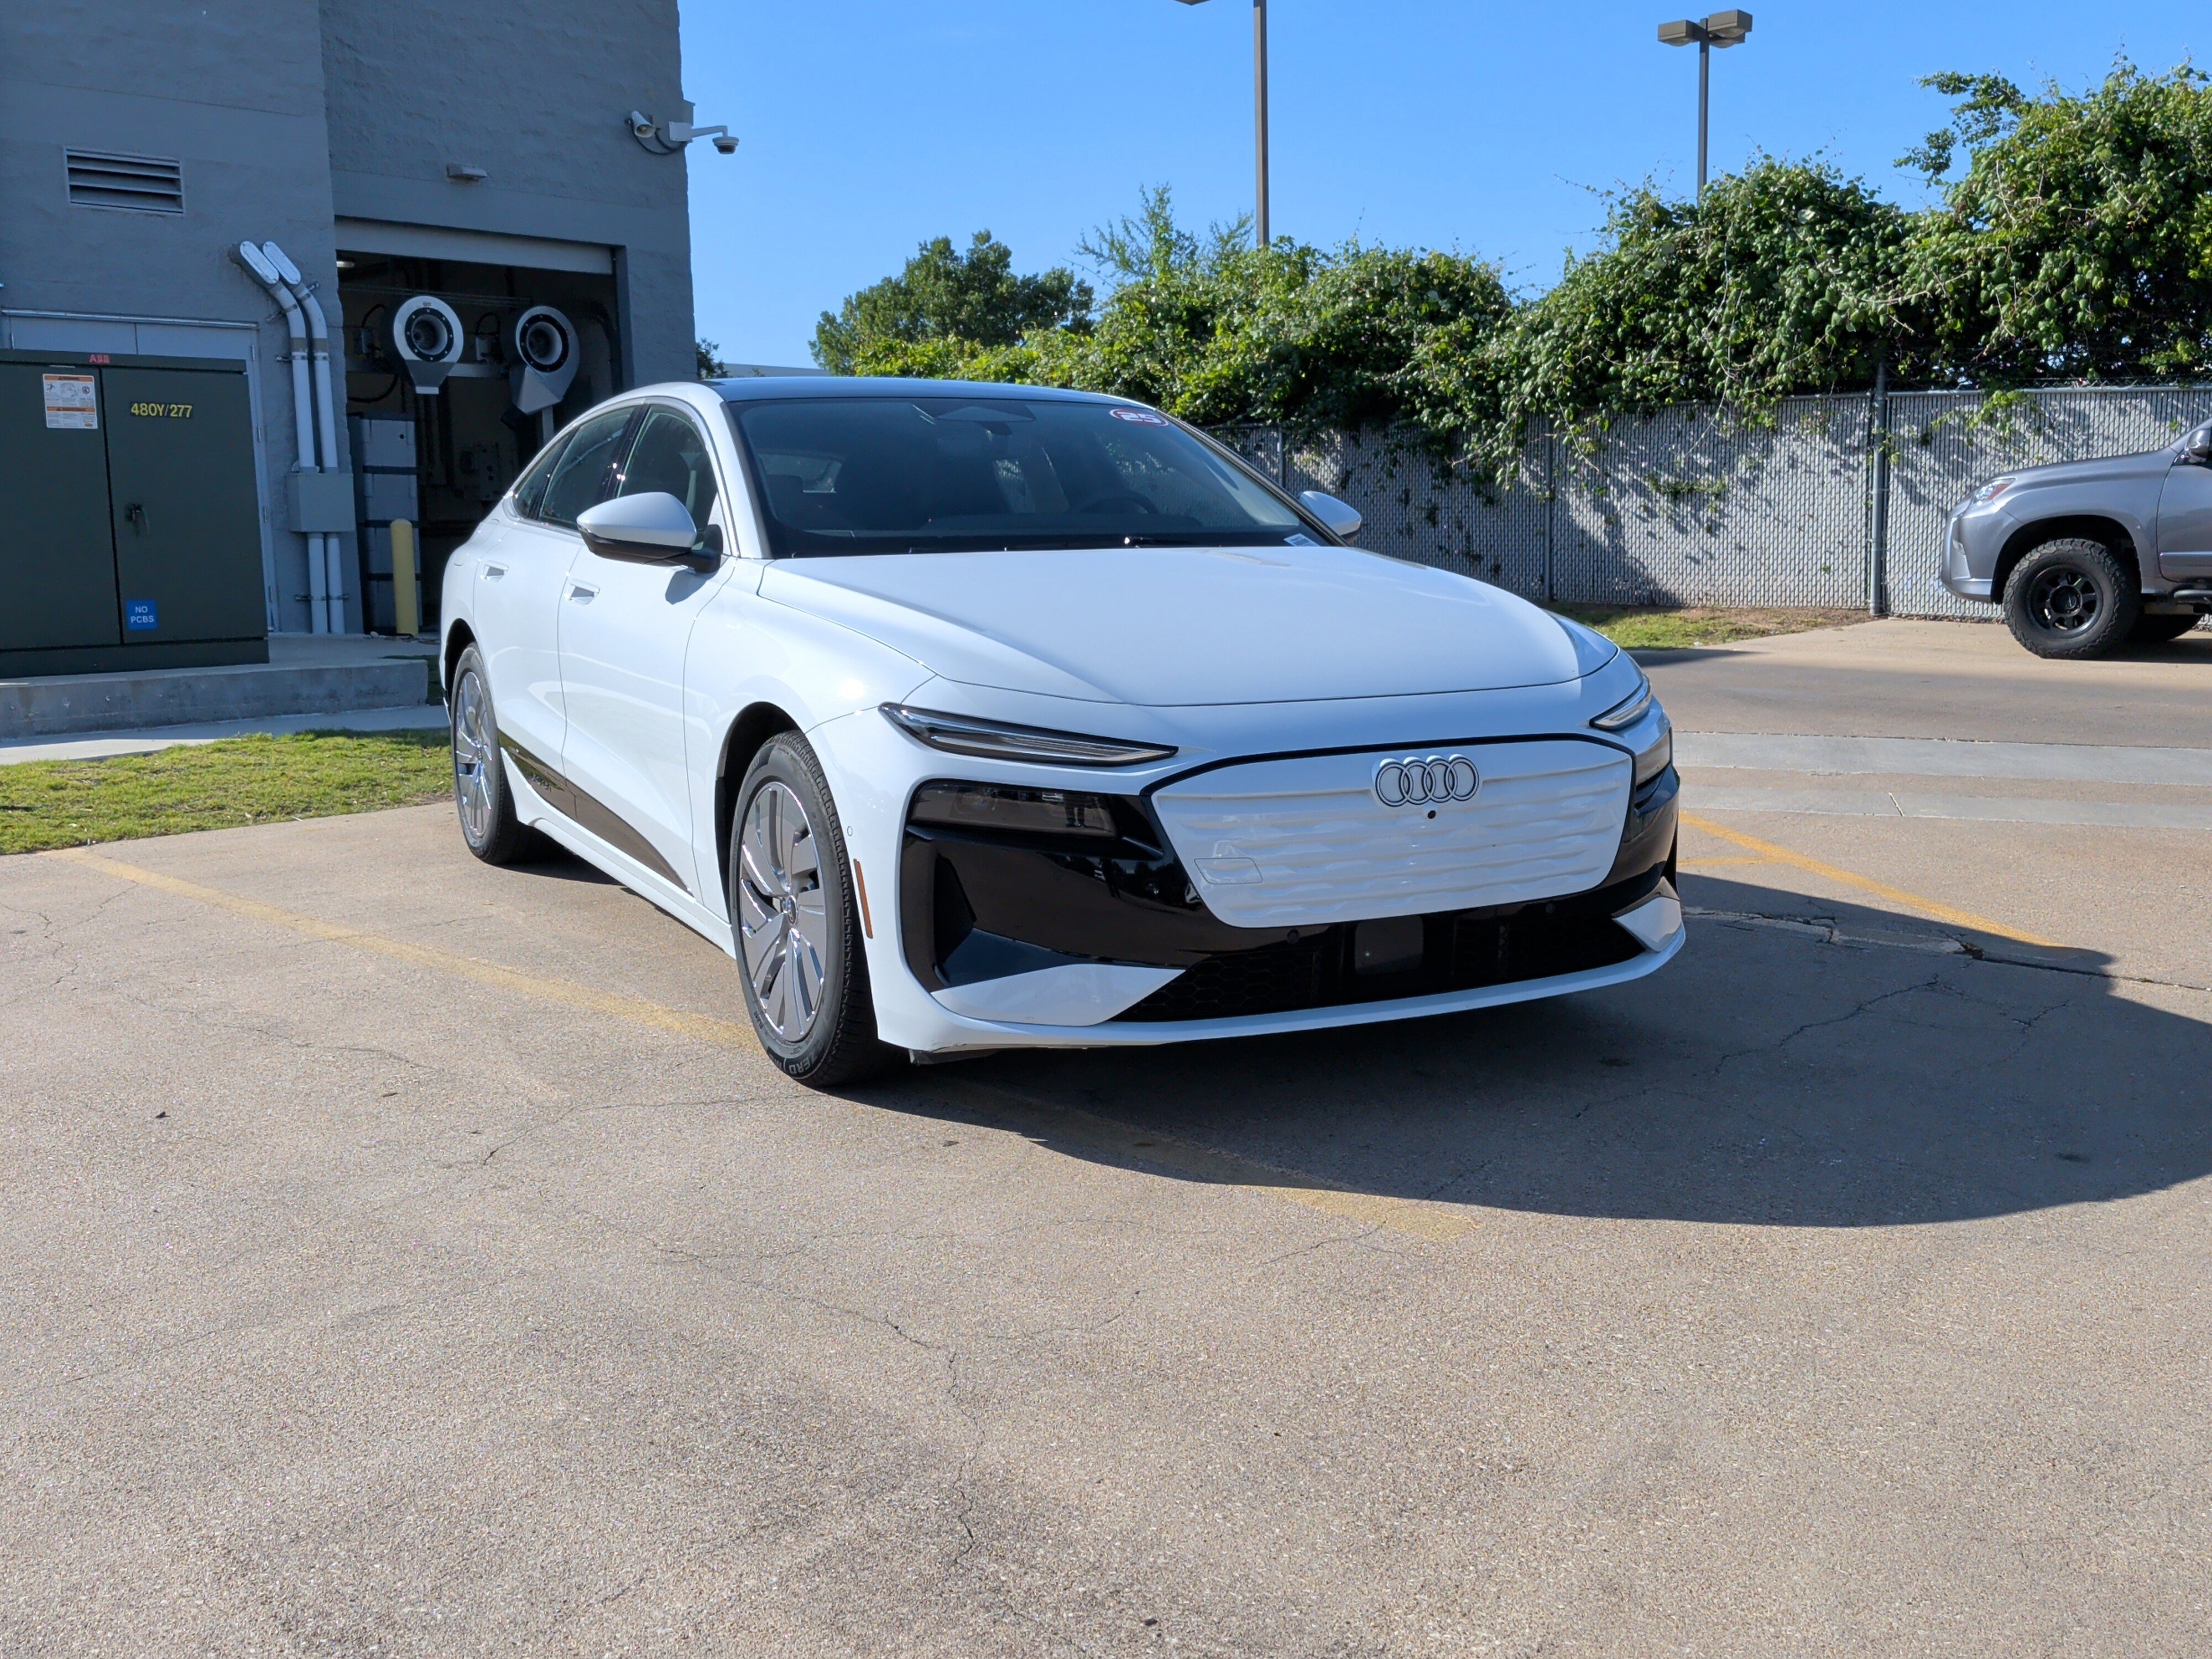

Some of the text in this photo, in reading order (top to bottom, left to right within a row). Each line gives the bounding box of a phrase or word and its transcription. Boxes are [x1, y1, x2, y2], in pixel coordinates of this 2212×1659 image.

[90, 354, 109, 363] ABB
[131, 403, 192, 418] 480Y/277
[1117, 411, 1161, 424] 25
[135, 606, 148, 614] NO
